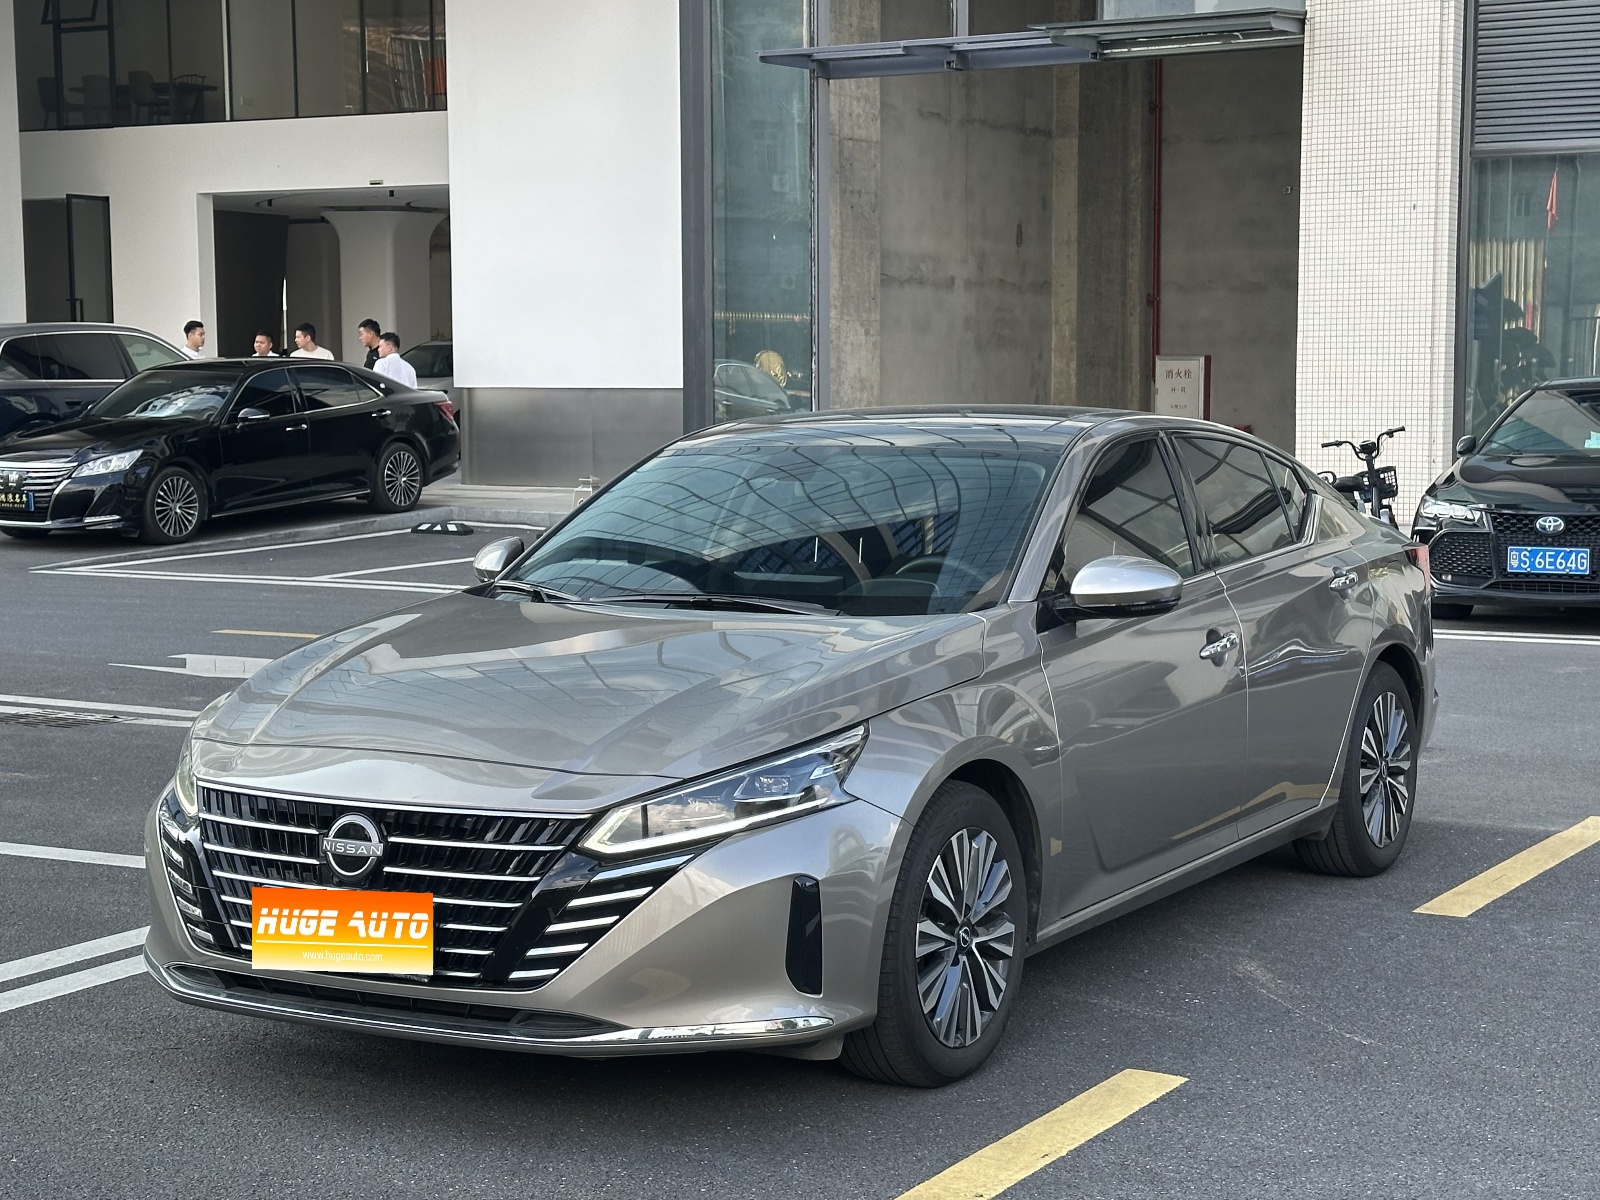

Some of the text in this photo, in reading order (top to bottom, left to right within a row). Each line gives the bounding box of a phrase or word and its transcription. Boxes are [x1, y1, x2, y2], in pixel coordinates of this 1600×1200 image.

[1165, 368, 1192, 379] 消火栓
[323, 840, 381, 855] NISSAN
[908, 847, 934, 921] OKOHAMA
